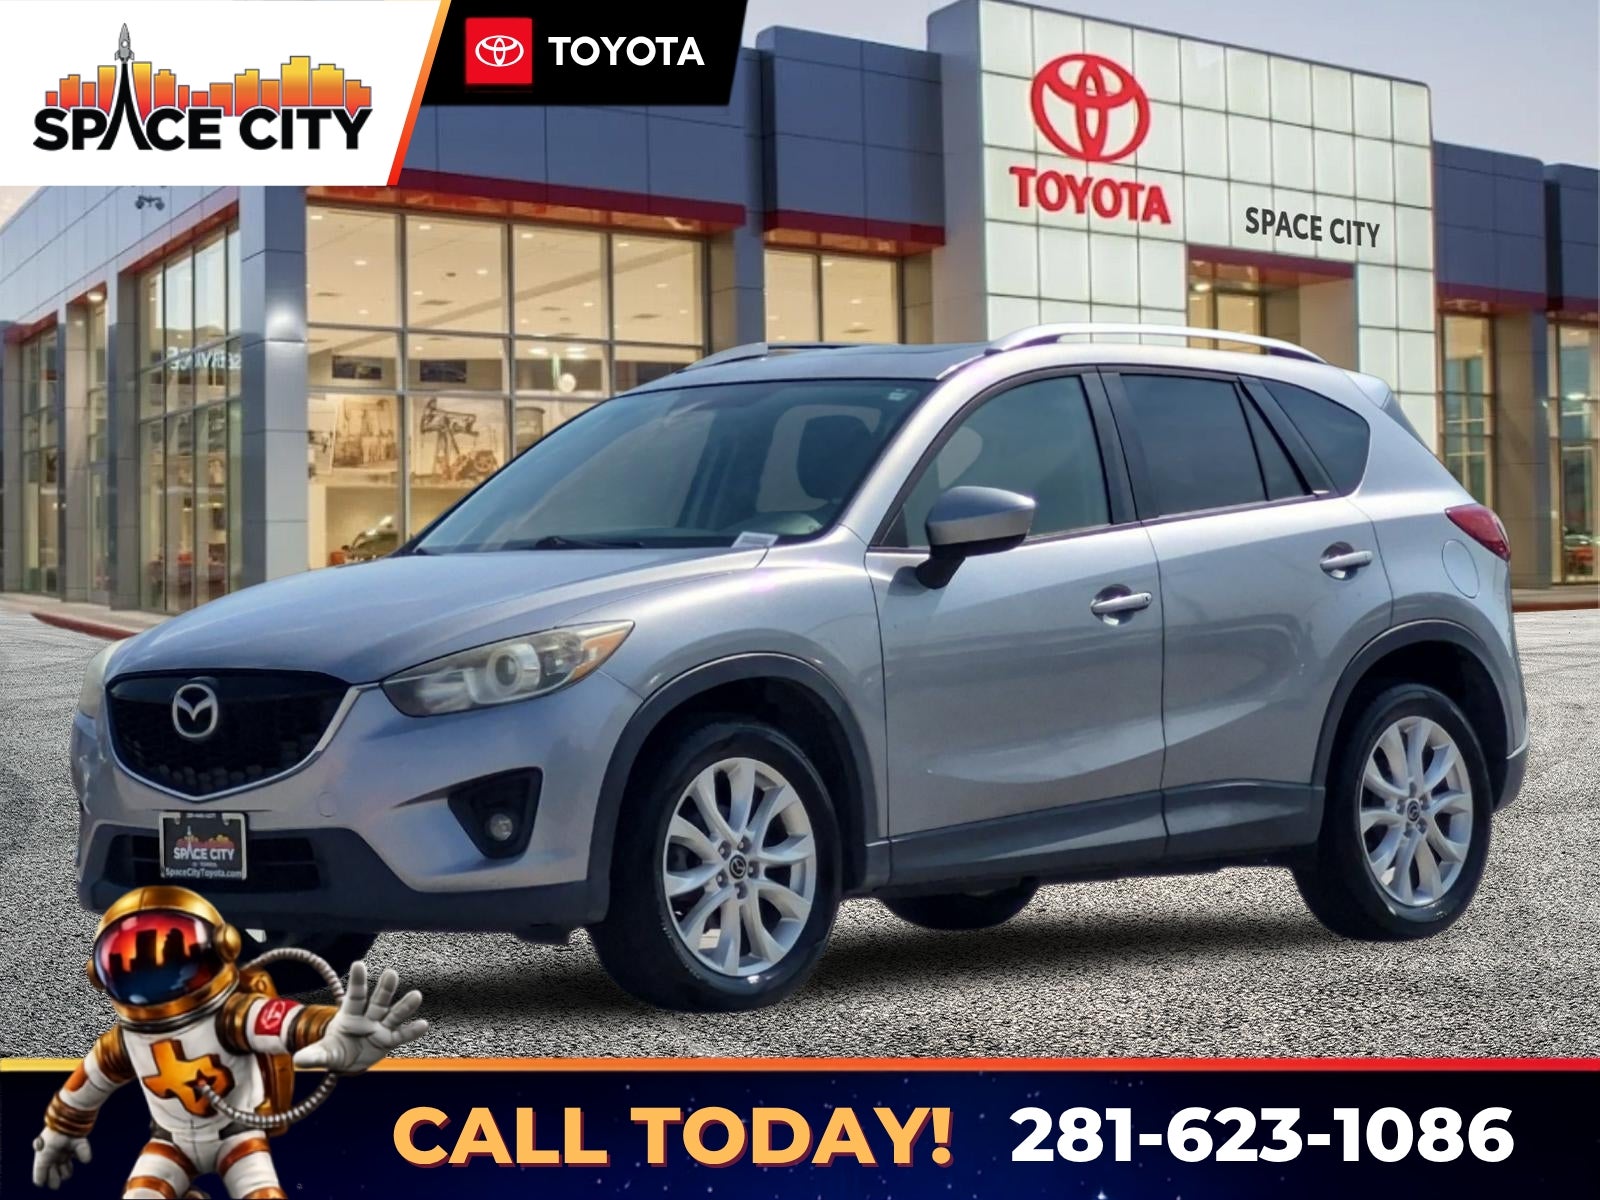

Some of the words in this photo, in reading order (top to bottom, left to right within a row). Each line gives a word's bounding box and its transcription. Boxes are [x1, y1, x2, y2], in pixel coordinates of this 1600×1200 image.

[1009, 166, 1171, 225] TOYOTA
[1245, 206, 1323, 242] SPACE
[1329, 217, 1381, 248] CITY
[173, 846, 207, 860] SPACE
[209, 848, 235, 860] CITY
[165, 867, 242, 878] SpaceCityToyota.com
